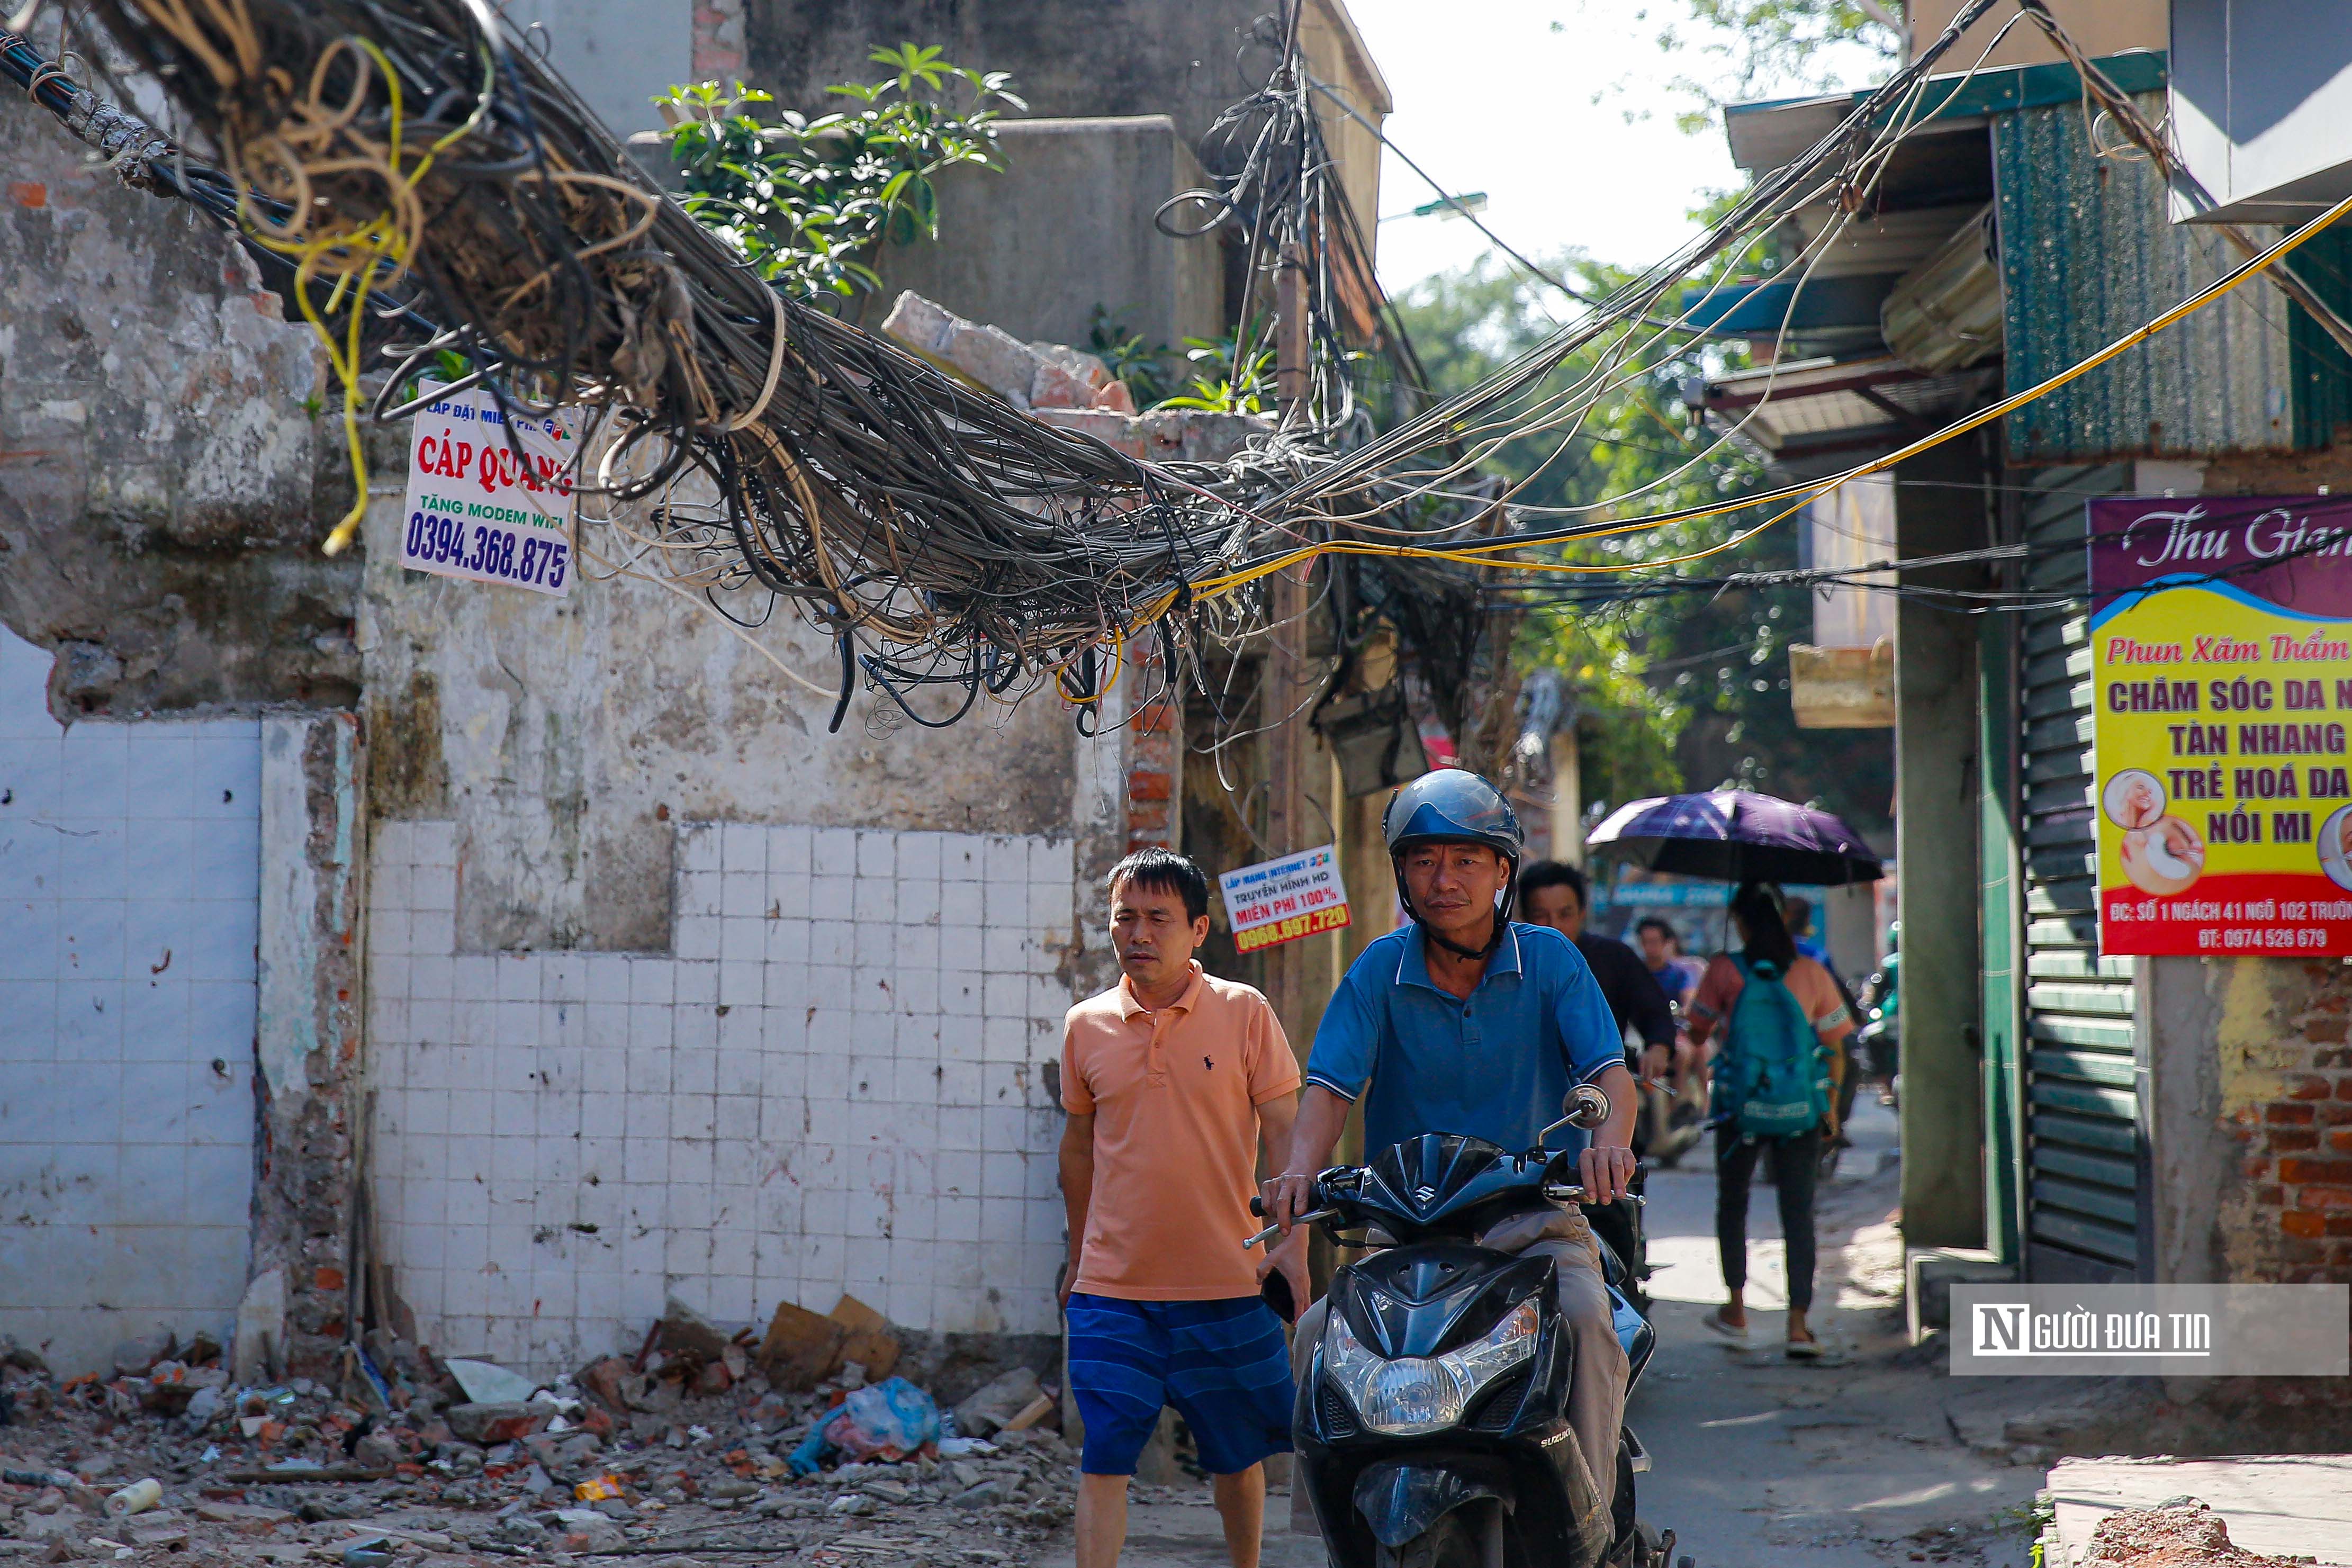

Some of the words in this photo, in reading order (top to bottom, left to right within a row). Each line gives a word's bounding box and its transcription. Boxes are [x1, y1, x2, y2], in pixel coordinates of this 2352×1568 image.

[418, 428, 473, 479] CÁP
[420, 493, 464, 514] TĂNG
[467, 503, 527, 525] MODEM
[406, 511, 567, 588] 0394.368.875
[2122, 503, 2231, 567] Thu
[2106, 635, 2183, 664] Phun
[2191, 633, 2260, 664] Xăm
[2270, 627, 2350, 662] Thẩm
[2107, 675, 2200, 714] CHĂM
[2209, 673, 2273, 713] SÓC
[2283, 679, 2327, 711] DA
[2239, 720, 2347, 756] NHANG
[2167, 761, 2225, 800] TRẺ
[2233, 762, 2299, 799] HOÁ
[2308, 767, 2350, 798] DA
[2206, 801, 2263, 844] NỐI
[2272, 811, 2312, 844] MI
[1311, 871, 1329, 884] HD
[1272, 893, 1297, 915] PHÍ
[1299, 886, 1338, 907] 100%
[2137, 897, 2160, 922] SỐ
[2160, 902, 2168, 922] 1
[2171, 898, 2221, 922] NGÁCH
[2223, 901, 2243, 922] 41
[2245, 898, 2276, 921] NGÕ
[2279, 902, 2308, 921] 102
[1236, 905, 1347, 951] 0968.697.720
[2223, 929, 2264, 948] 0974
[2265, 929, 2295, 948] 526
[2297, 929, 2327, 948] 679
[1540, 1427, 1571, 1448] SUZUKI
